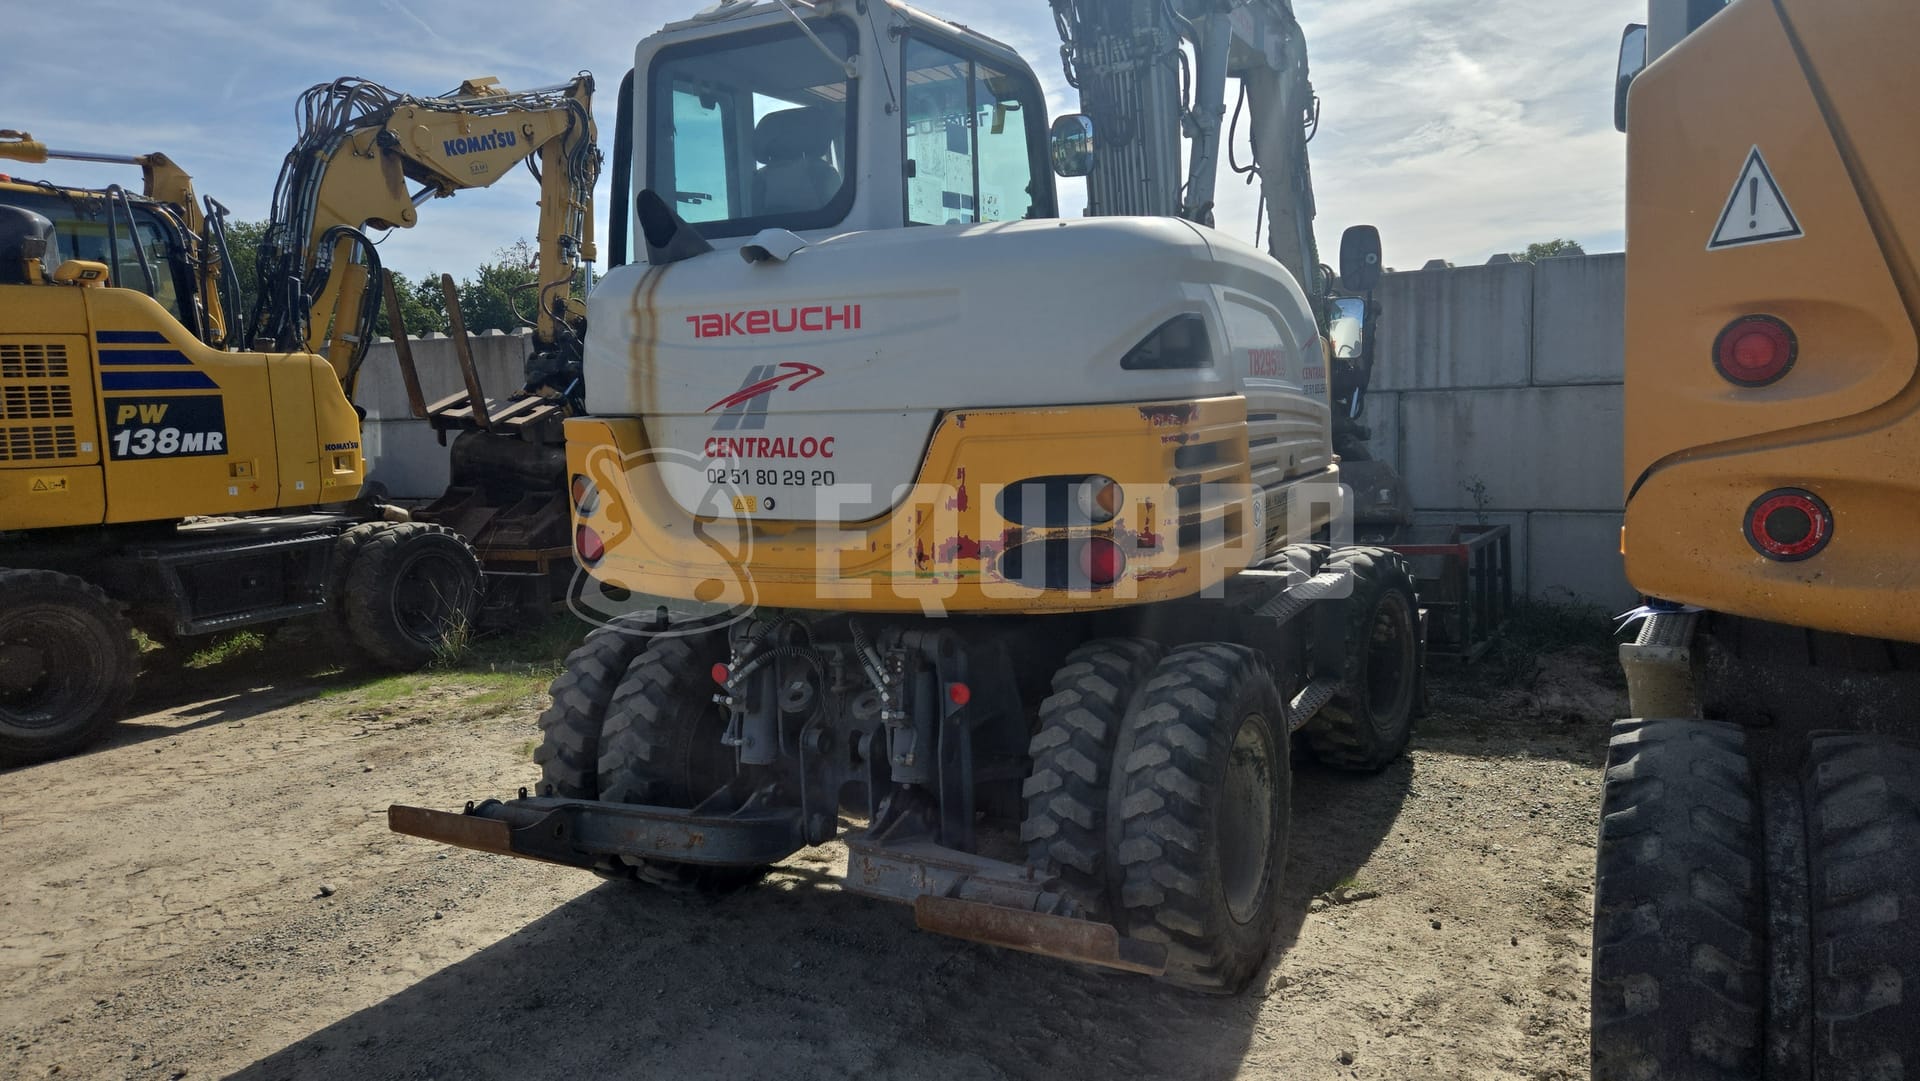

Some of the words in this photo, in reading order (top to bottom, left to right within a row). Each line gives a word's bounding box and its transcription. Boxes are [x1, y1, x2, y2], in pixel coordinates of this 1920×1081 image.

[443, 129, 516, 157] KOMATSU
[686, 304, 861, 338] TAKEUCHI
[116, 404, 168, 425] PW
[114, 427, 223, 456] 138MR
[325, 441, 359, 451] KOMATSU
[704, 436, 835, 458] CENTRALOC
[707, 469, 727, 484] 02
[731, 469, 750, 485] 51
[756, 469, 777, 485] 80
[783, 470, 805, 486] 29
[812, 470, 835, 486] 20
